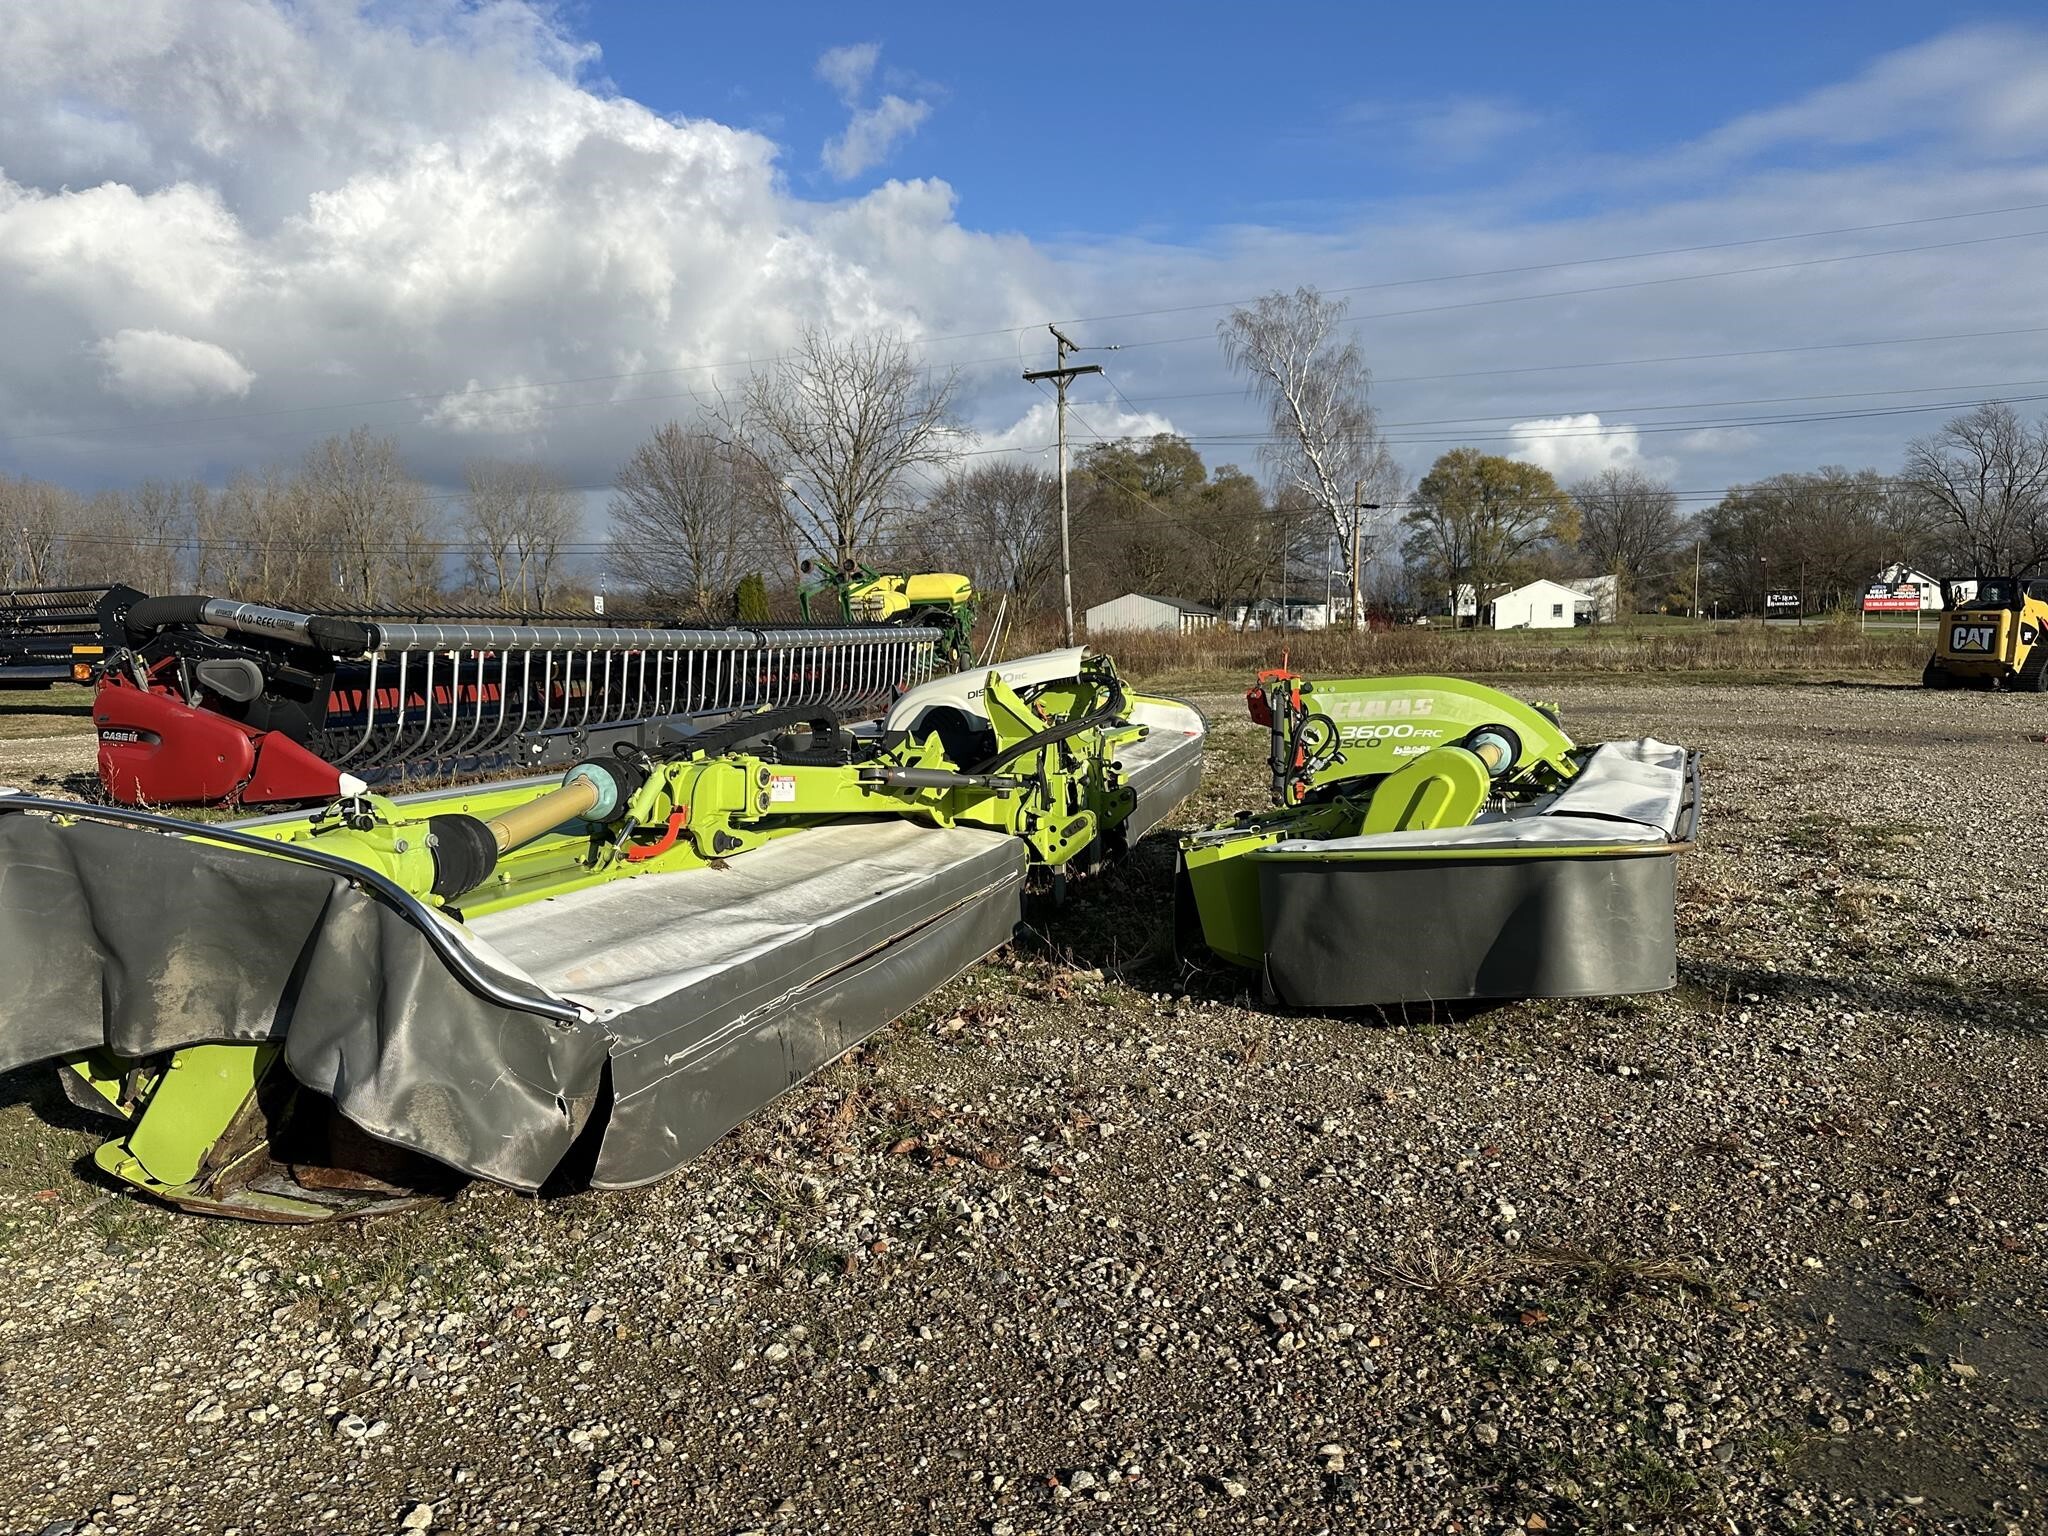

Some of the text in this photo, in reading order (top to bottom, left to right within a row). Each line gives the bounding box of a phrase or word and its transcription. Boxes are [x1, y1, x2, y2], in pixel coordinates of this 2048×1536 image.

[1953, 627, 1994, 650] CAT
[1333, 698, 1434, 718] CLAAS
[102, 731, 129, 741] CASE
[1340, 724, 1444, 739] 3600 FRC
